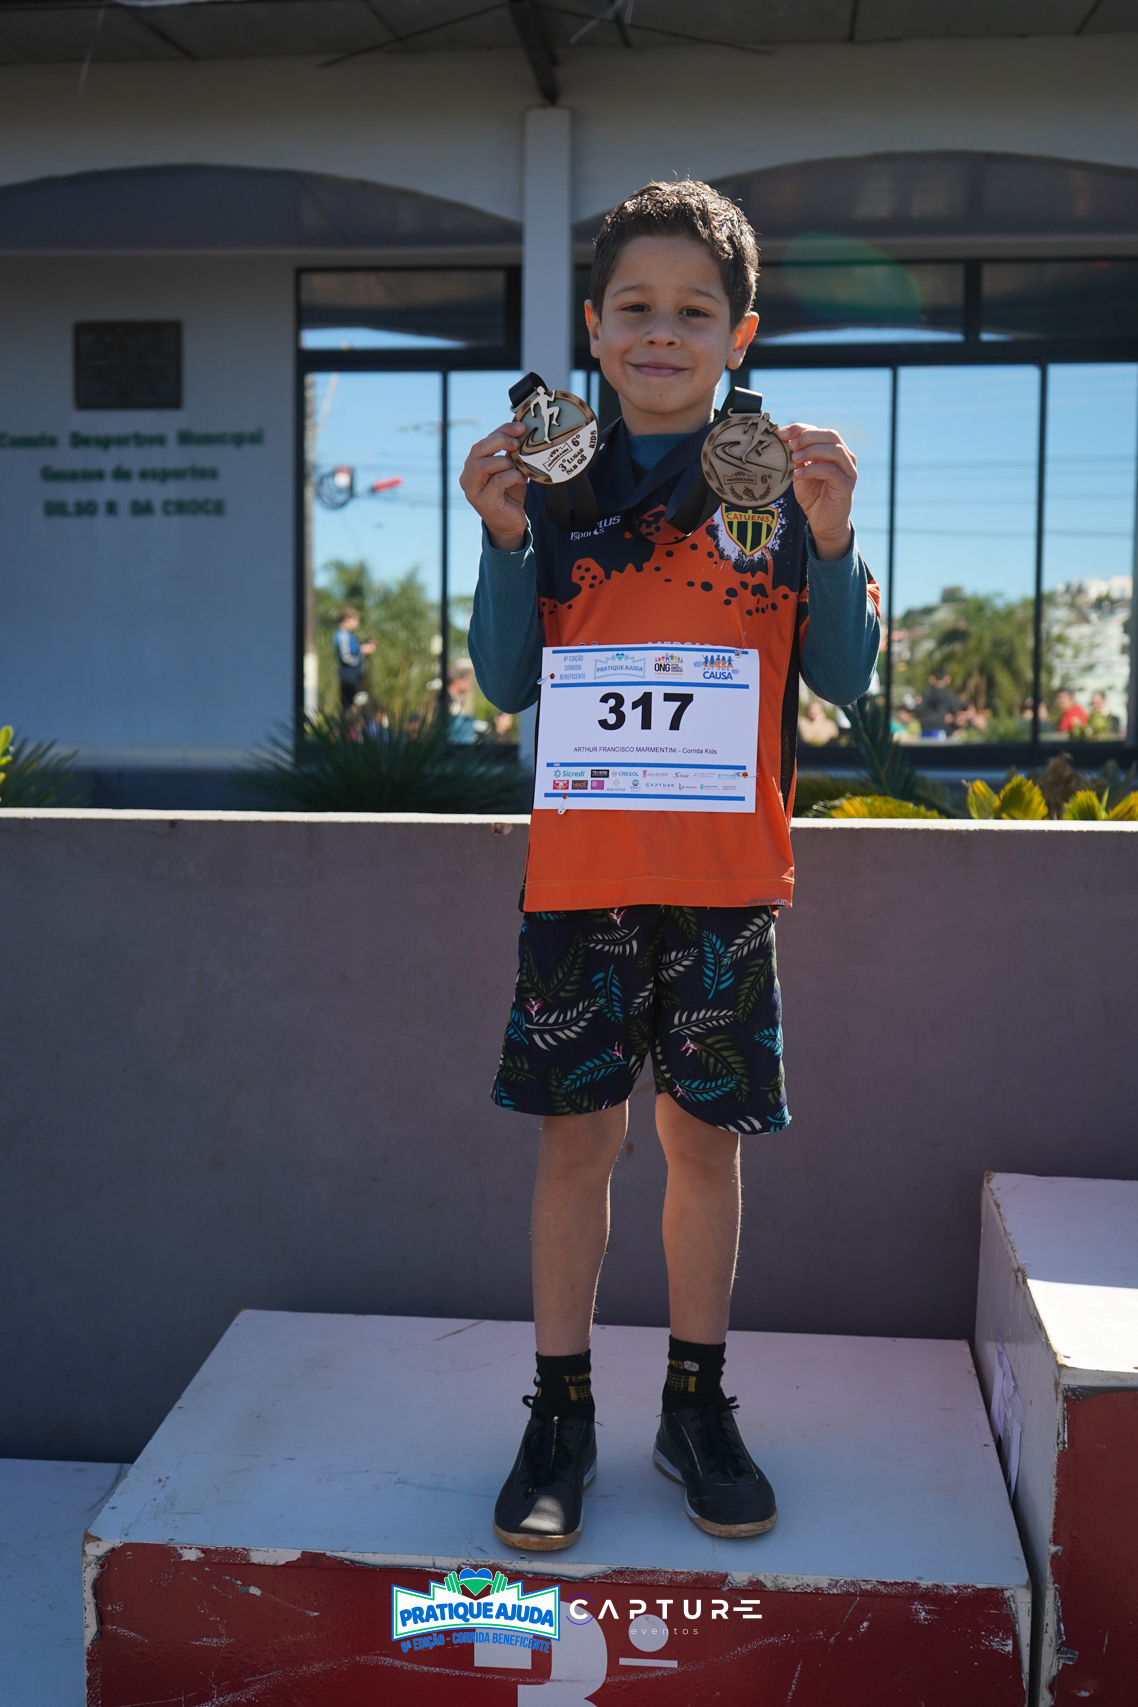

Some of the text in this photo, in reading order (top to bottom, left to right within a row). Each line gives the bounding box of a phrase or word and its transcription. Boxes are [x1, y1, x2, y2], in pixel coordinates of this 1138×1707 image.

[726, 513, 775, 526] CATUENSE
[597, 665, 624, 673] PRATIQUE
[654, 662, 670, 672] ONG
[703, 671, 733, 680] CAUSA
[597, 691, 694, 731] 317
[704, 747, 718, 755] Kids
